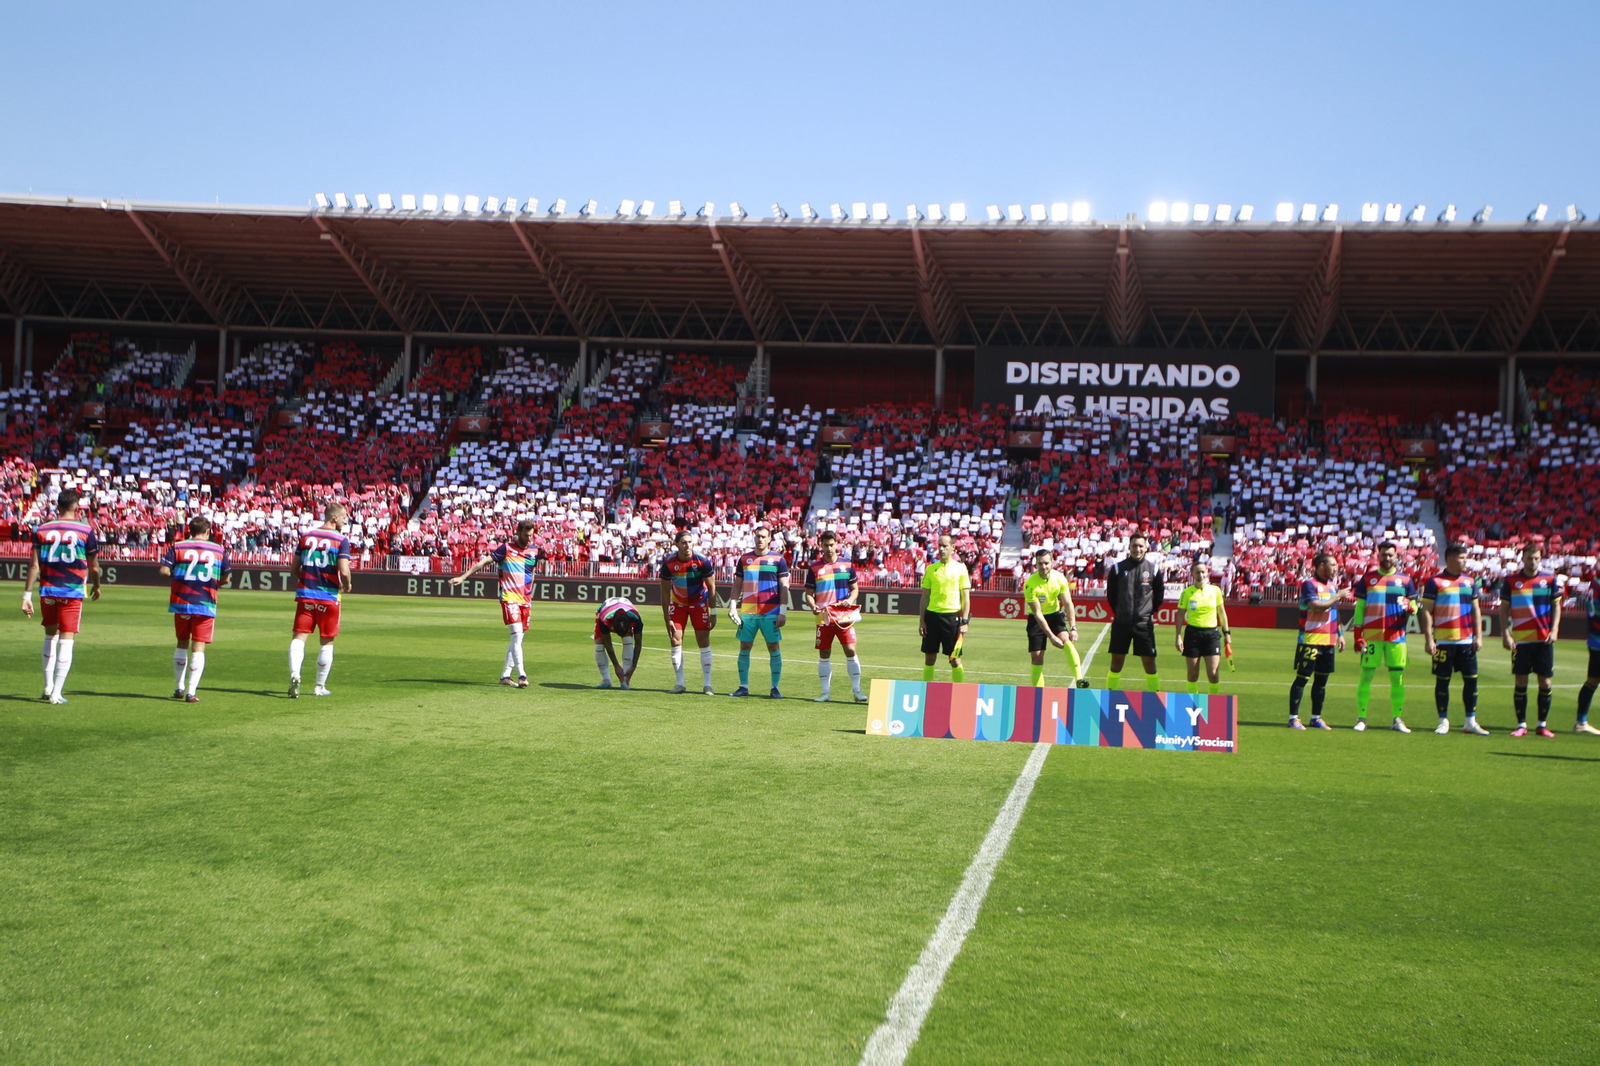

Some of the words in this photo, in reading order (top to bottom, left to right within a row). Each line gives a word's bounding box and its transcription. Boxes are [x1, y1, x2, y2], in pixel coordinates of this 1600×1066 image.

[1006, 361, 1240, 388] DISFRUTANDO
[1015, 394, 1075, 417] LAS
[1085, 395, 1230, 420] HERIDAS
[45, 530, 78, 563] 23
[303, 536, 331, 568] 23
[184, 549, 215, 582] 23
[407, 578, 485, 597] BETTER
[577, 584, 646, 602] STOPS
[508, 604, 519, 614] 12
[1303, 647, 1318, 660] 22
[1433, 648, 1447, 663] 25
[1154, 734, 1234, 748] #unityVSracism
